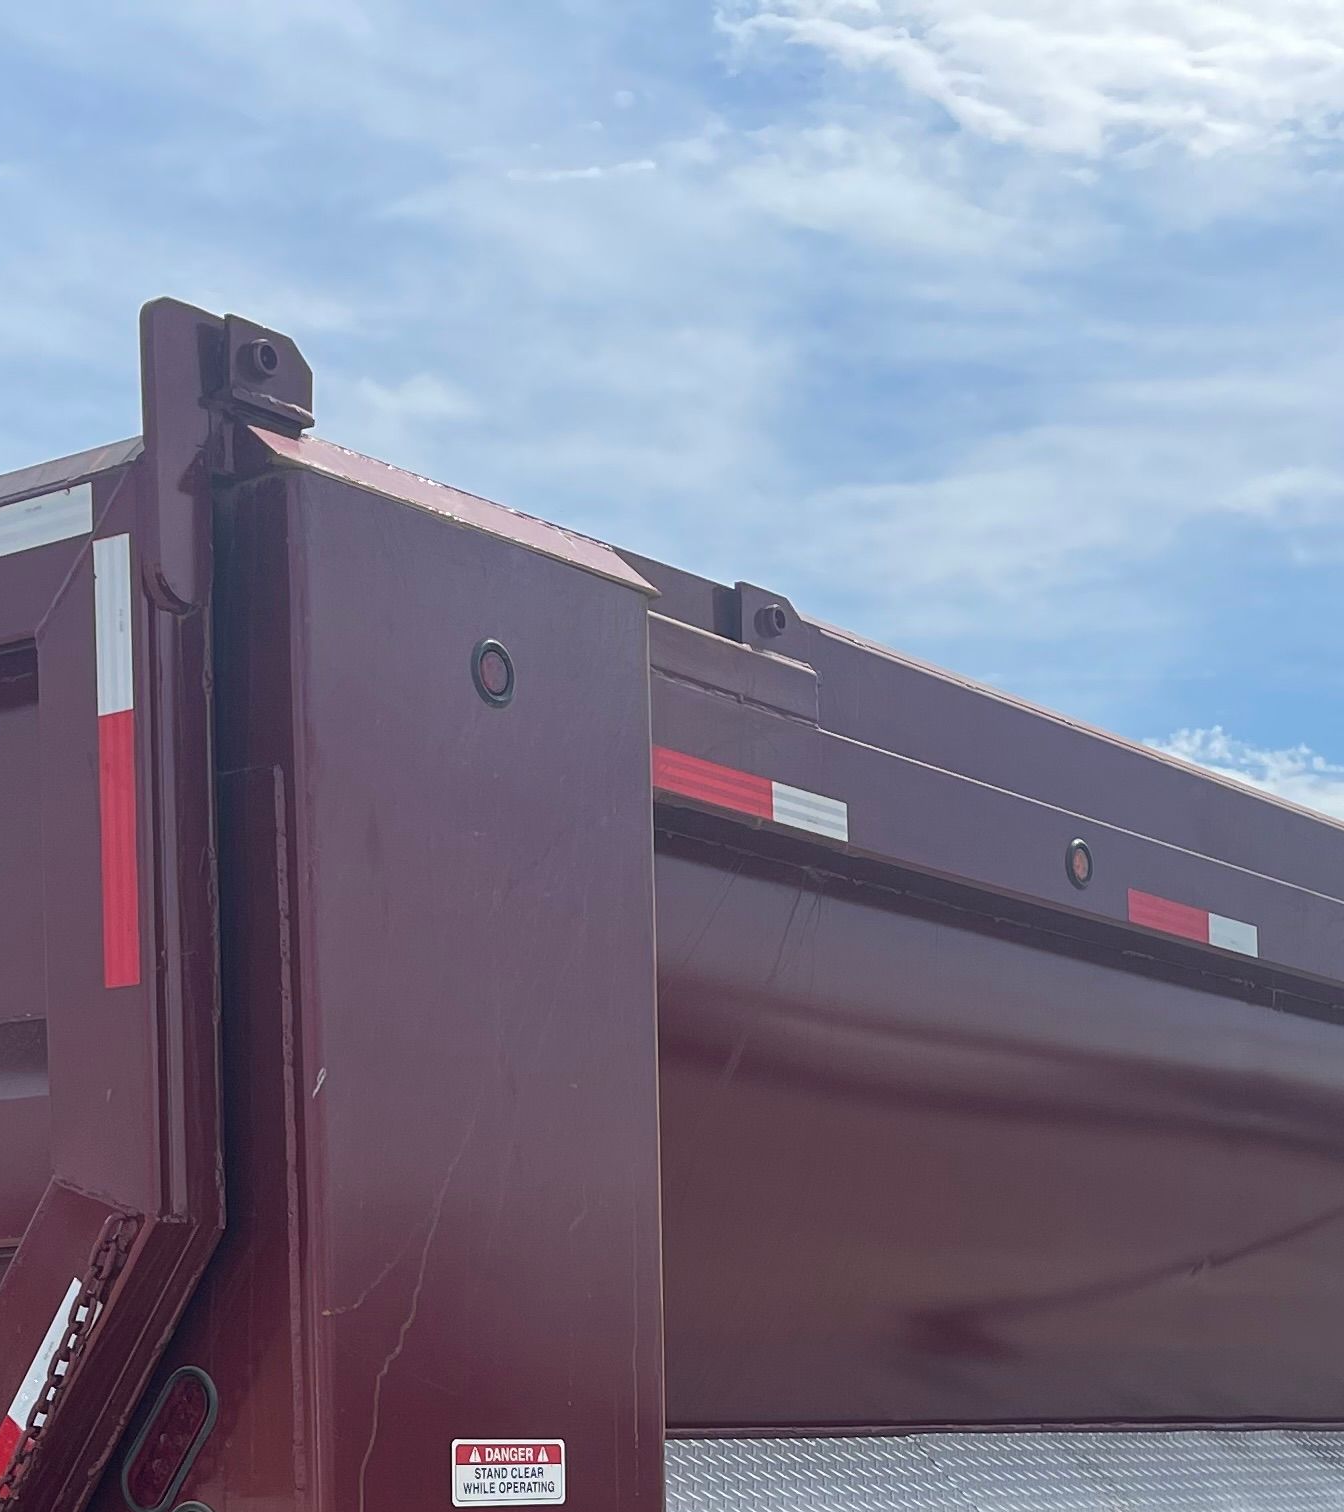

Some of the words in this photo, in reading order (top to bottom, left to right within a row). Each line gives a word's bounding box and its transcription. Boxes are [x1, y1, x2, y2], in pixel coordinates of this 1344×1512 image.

[485, 1447, 534, 1462] DANGER
[474, 1467, 508, 1479] STAND
[510, 1467, 544, 1479] CLEAR
[463, 1482, 496, 1494] WHILE
[498, 1480, 555, 1493] OPERATING
